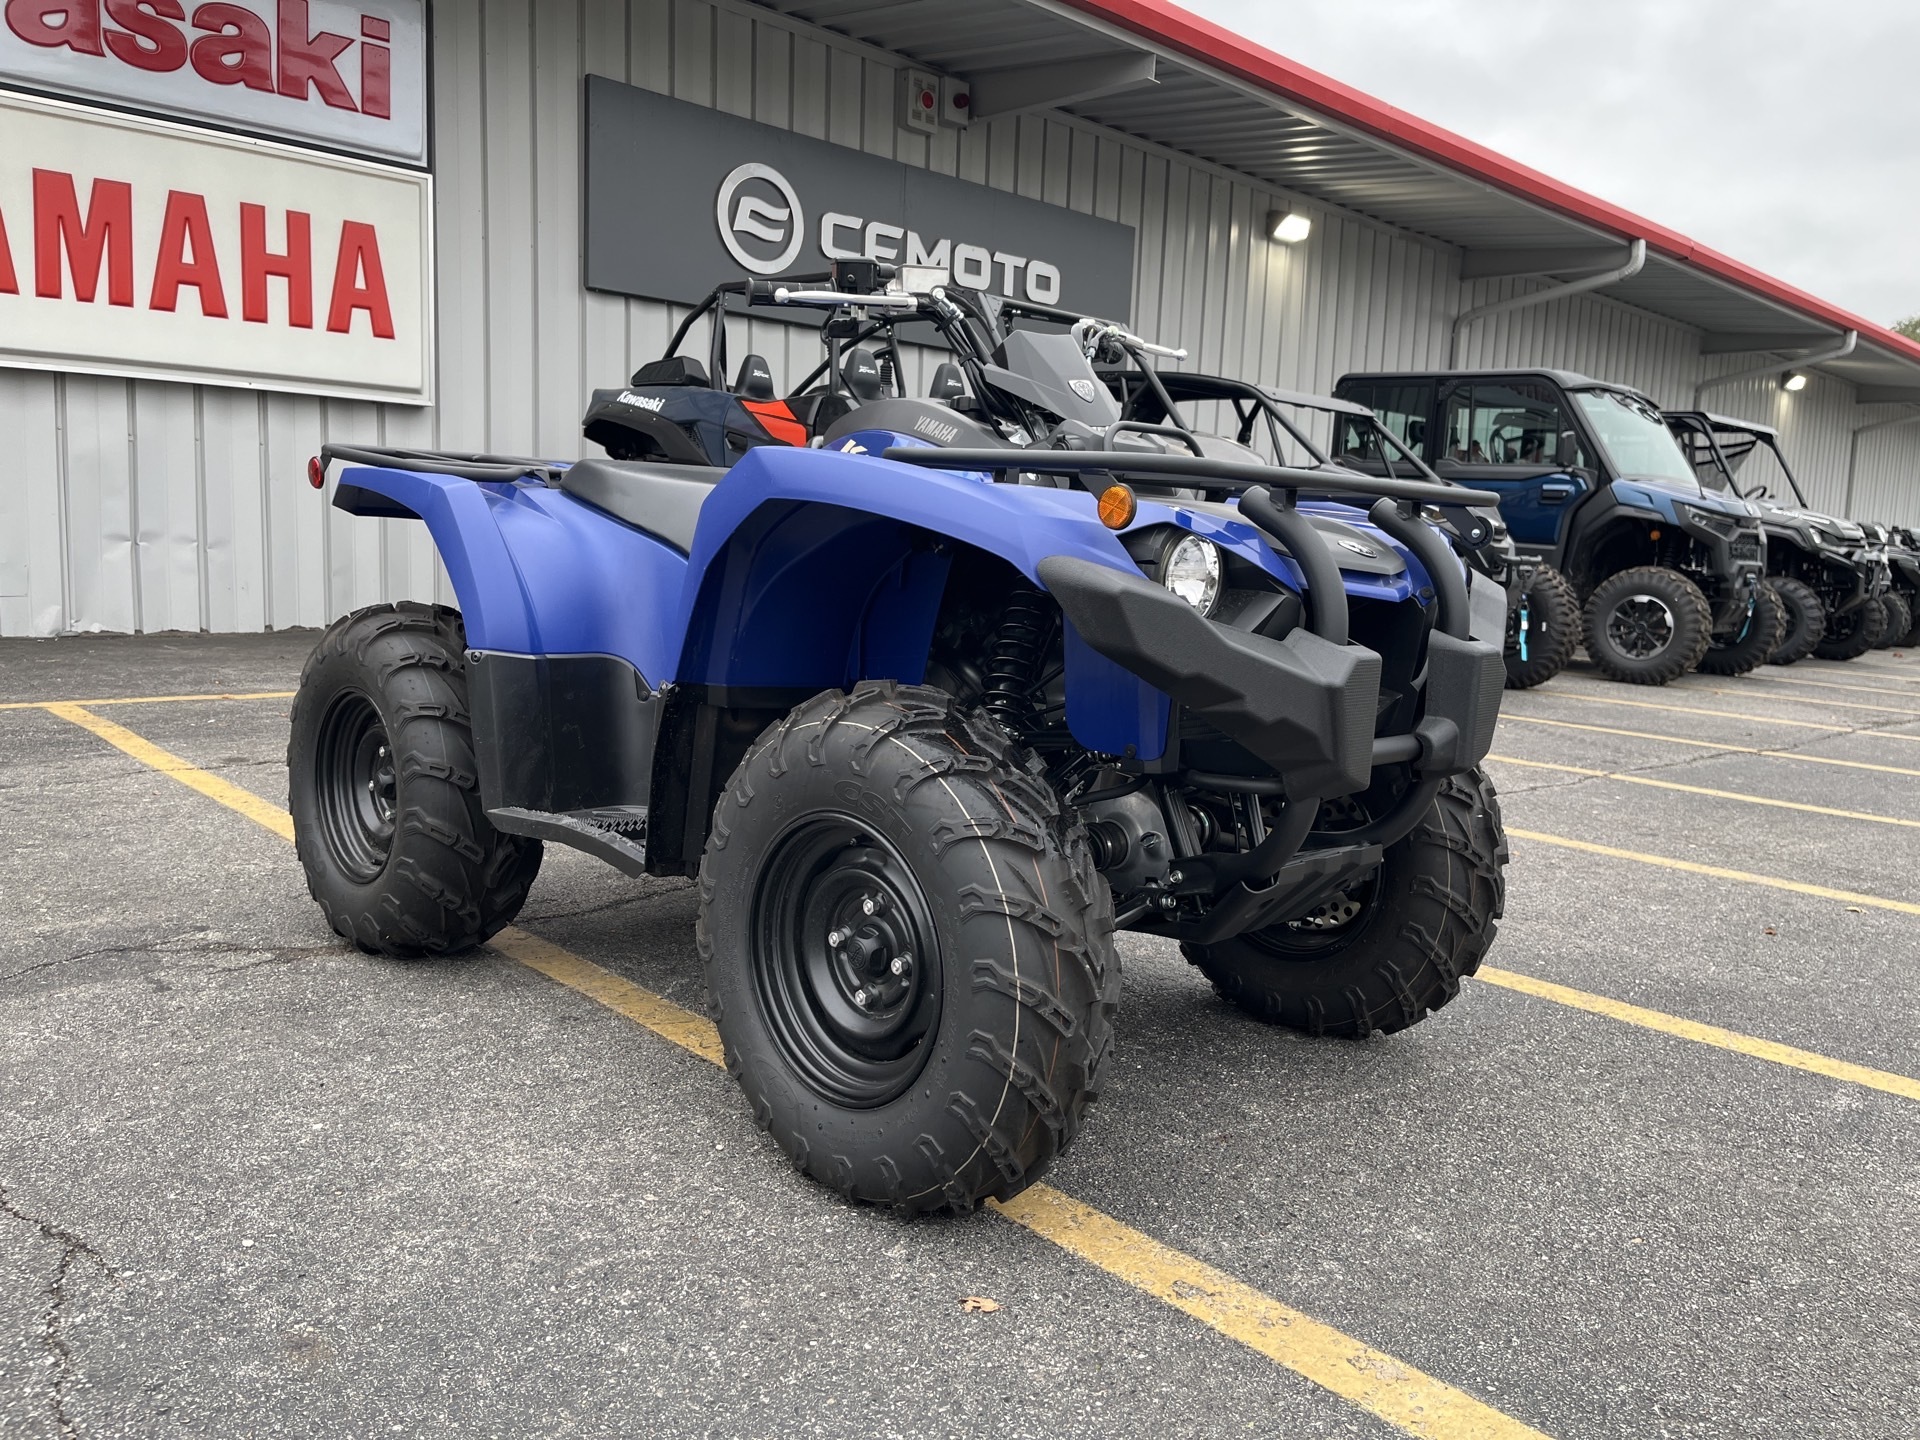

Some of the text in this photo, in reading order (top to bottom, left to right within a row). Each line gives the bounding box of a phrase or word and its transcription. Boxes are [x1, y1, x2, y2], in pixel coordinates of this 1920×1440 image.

[0, 168, 395, 340] MAHA
[821, 212, 1061, 305] CFMOTO
[616, 390, 666, 413] Kawasaki
[913, 415, 959, 443] YAMAHA
